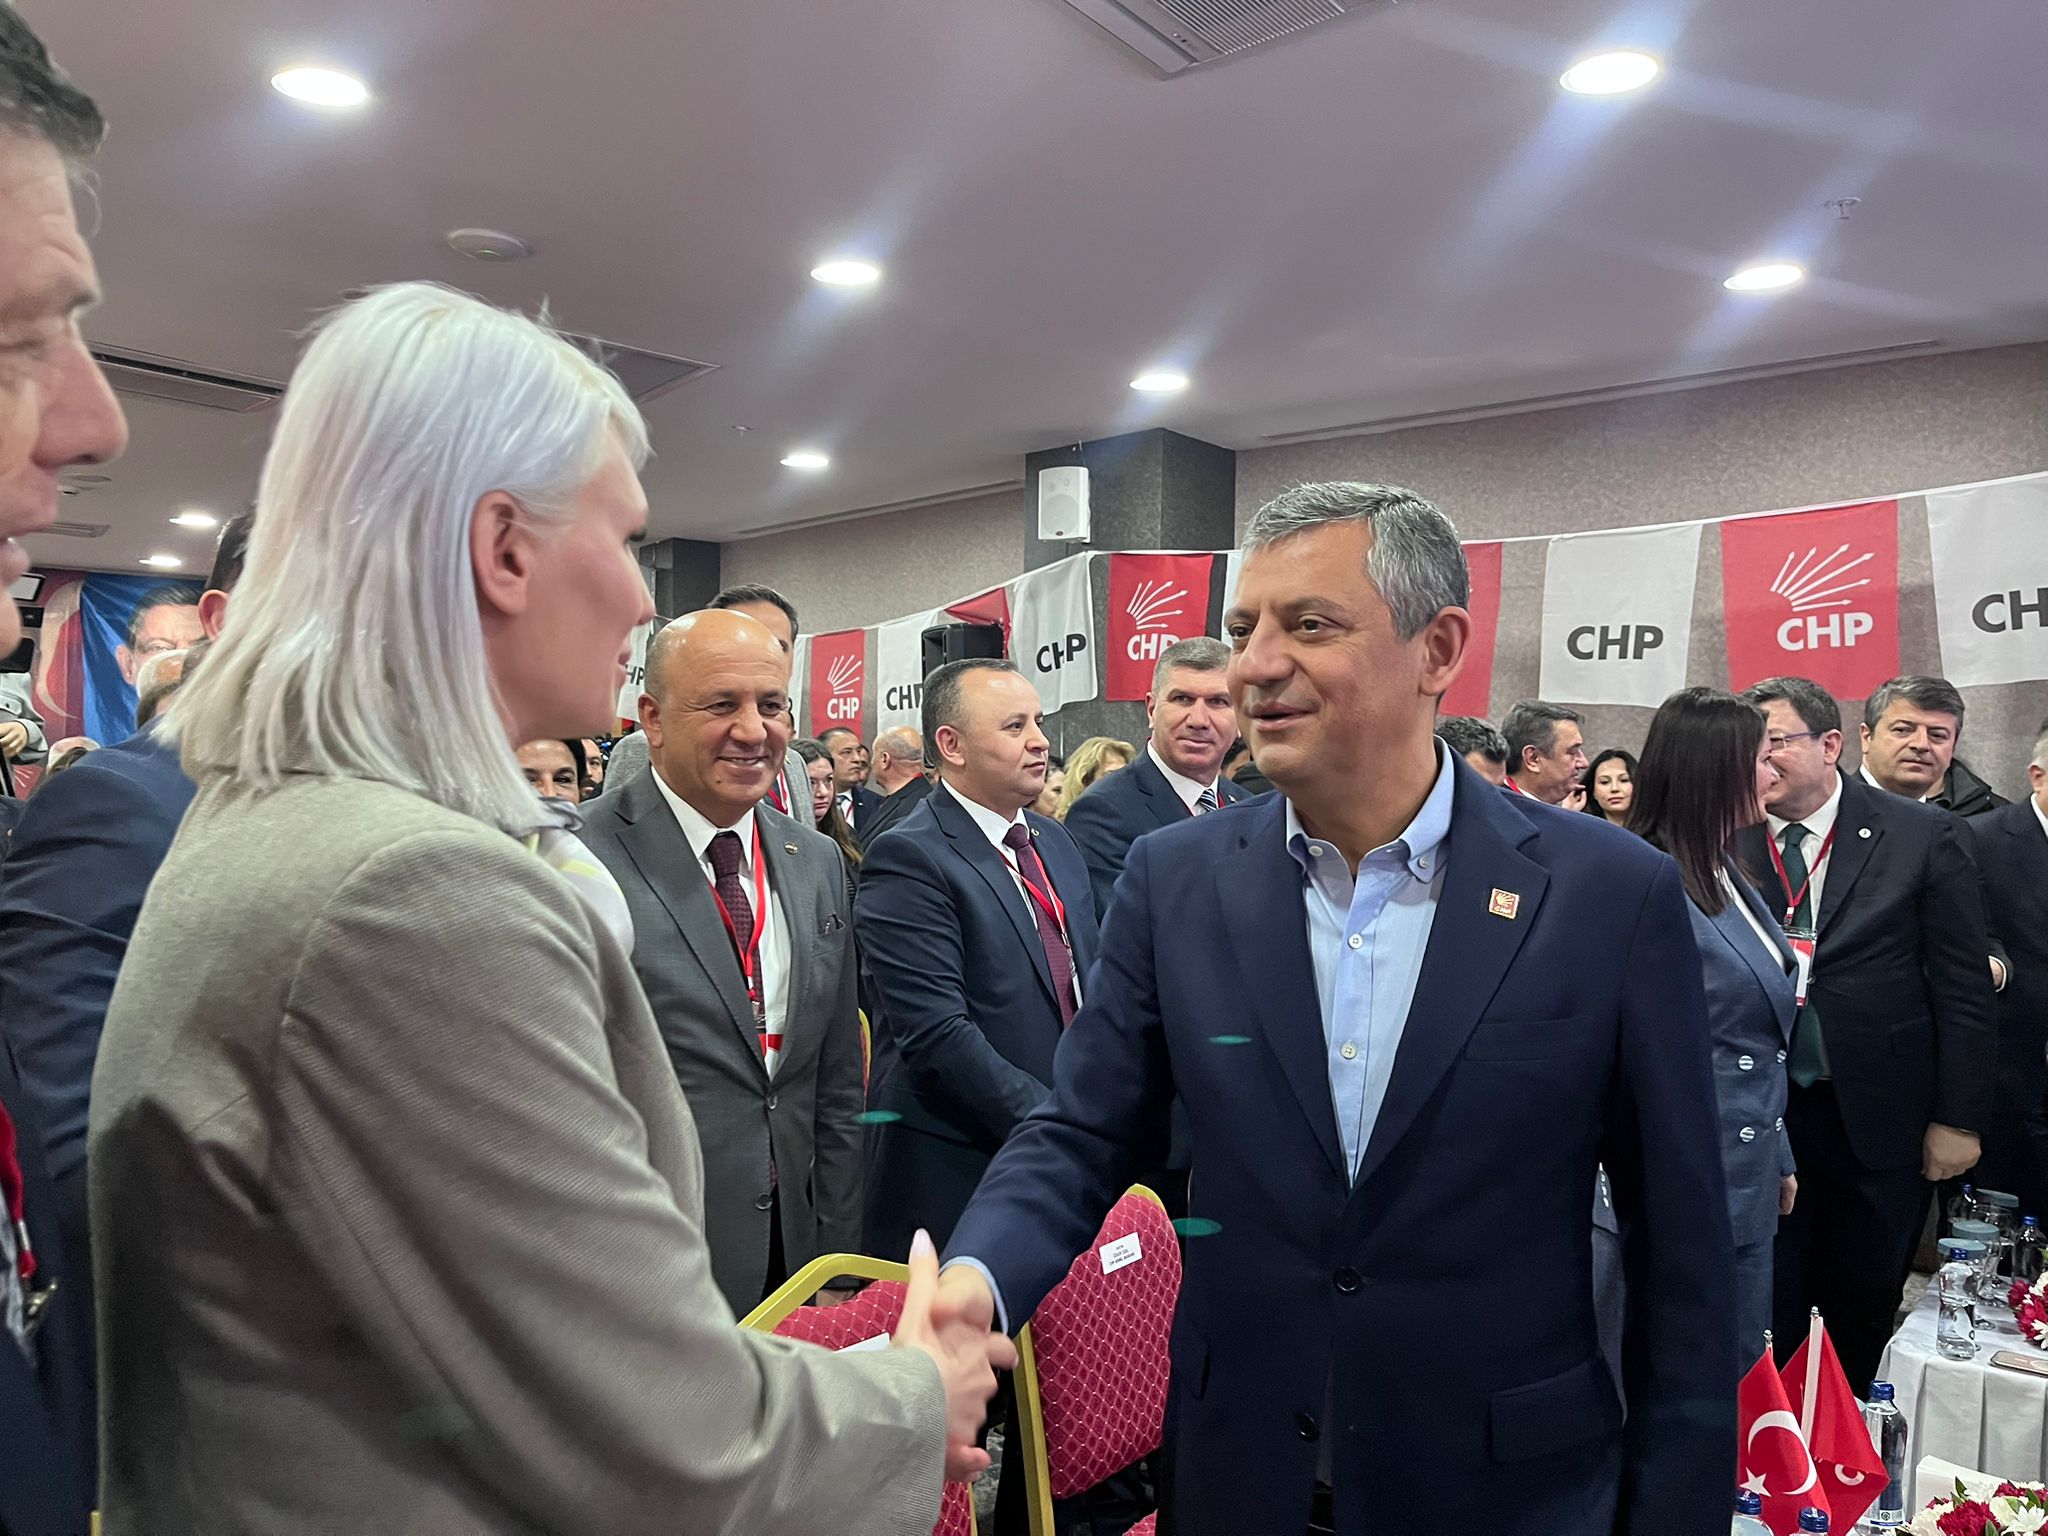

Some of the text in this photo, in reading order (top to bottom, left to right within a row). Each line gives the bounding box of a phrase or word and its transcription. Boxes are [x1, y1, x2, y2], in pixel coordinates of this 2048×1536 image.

[1972, 587, 2048, 633] CH
[1567, 624, 1664, 660] CHP
[1776, 611, 1874, 651] CHP
[1036, 633, 1087, 673] CHP
[626, 664, 645, 686] HP
[827, 697, 860, 719] CHP
